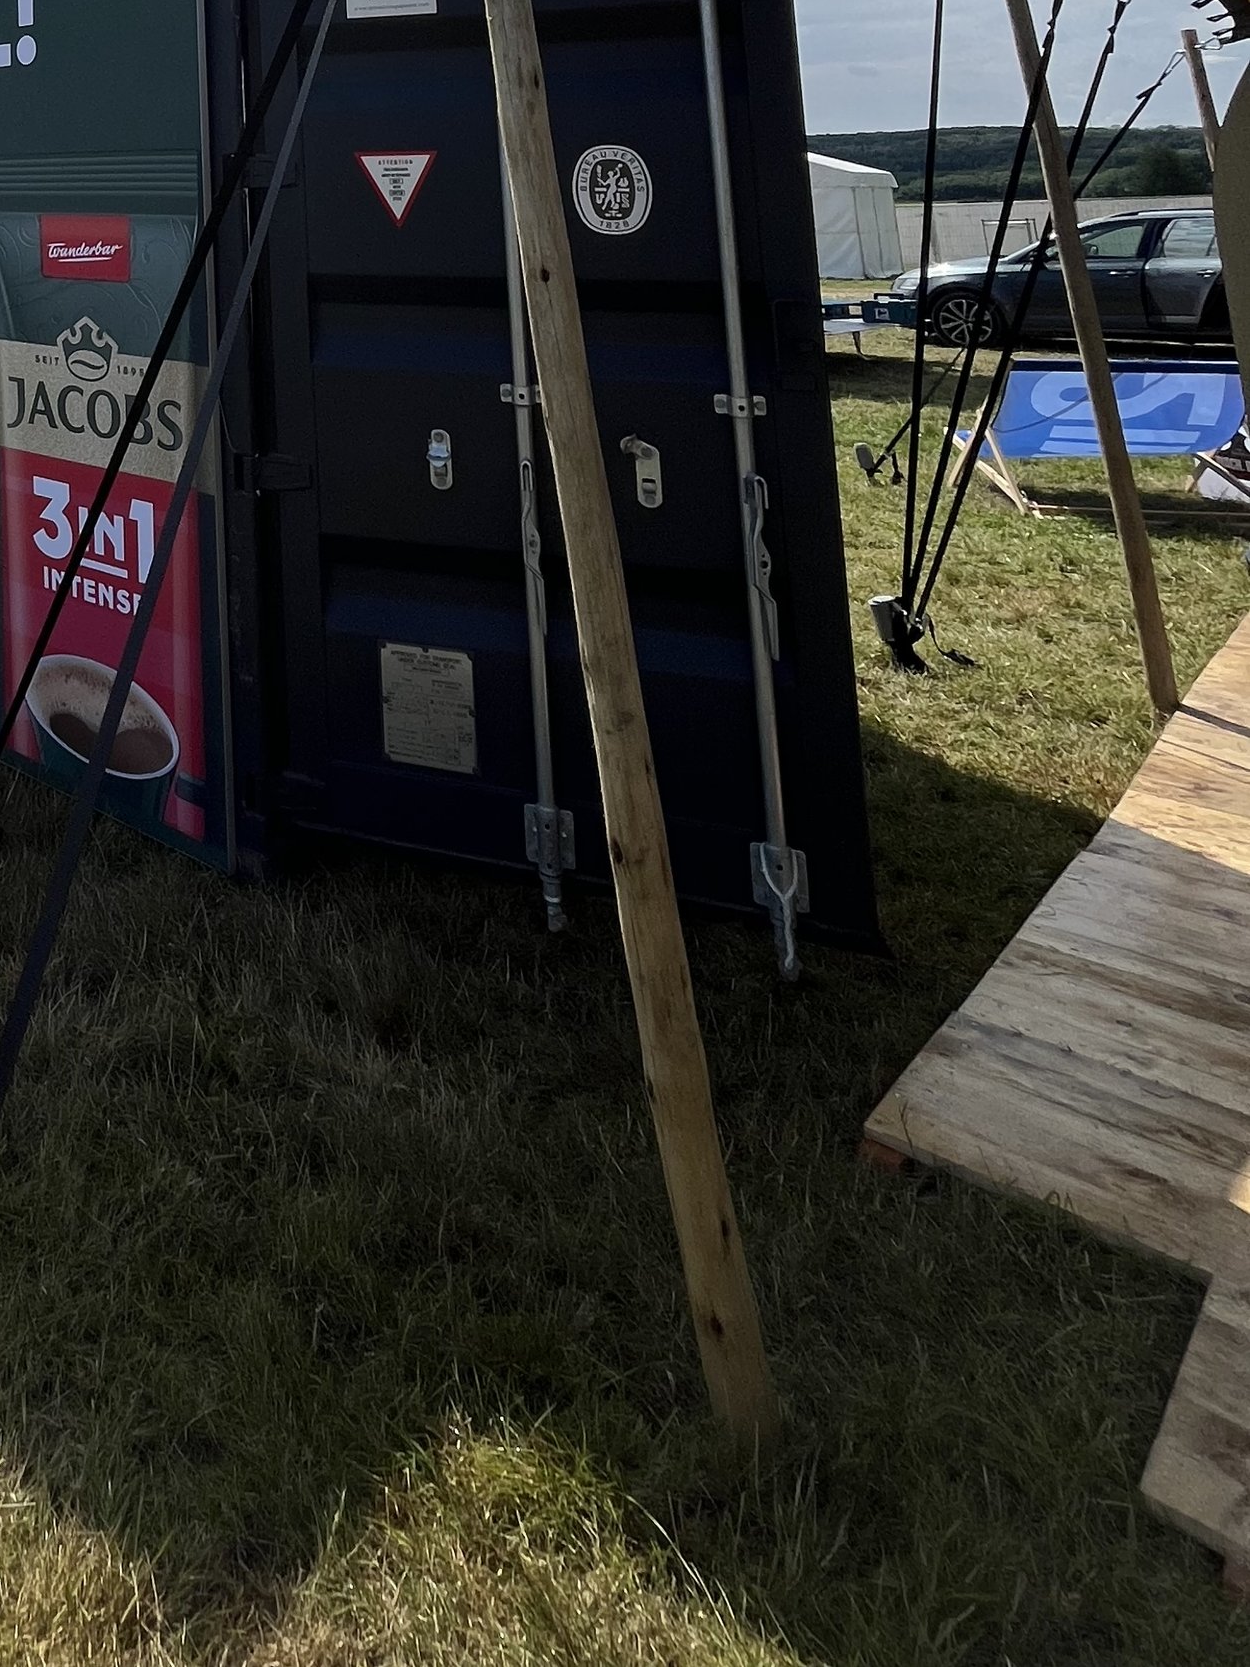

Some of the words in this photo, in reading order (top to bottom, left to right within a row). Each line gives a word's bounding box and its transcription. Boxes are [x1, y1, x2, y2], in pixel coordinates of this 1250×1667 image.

[579, 151, 607, 192] BUREAU
[612, 150, 645, 192] VERITAS
[34, 354, 59, 366] SEIT
[6, 376, 183, 451] JACOBS
